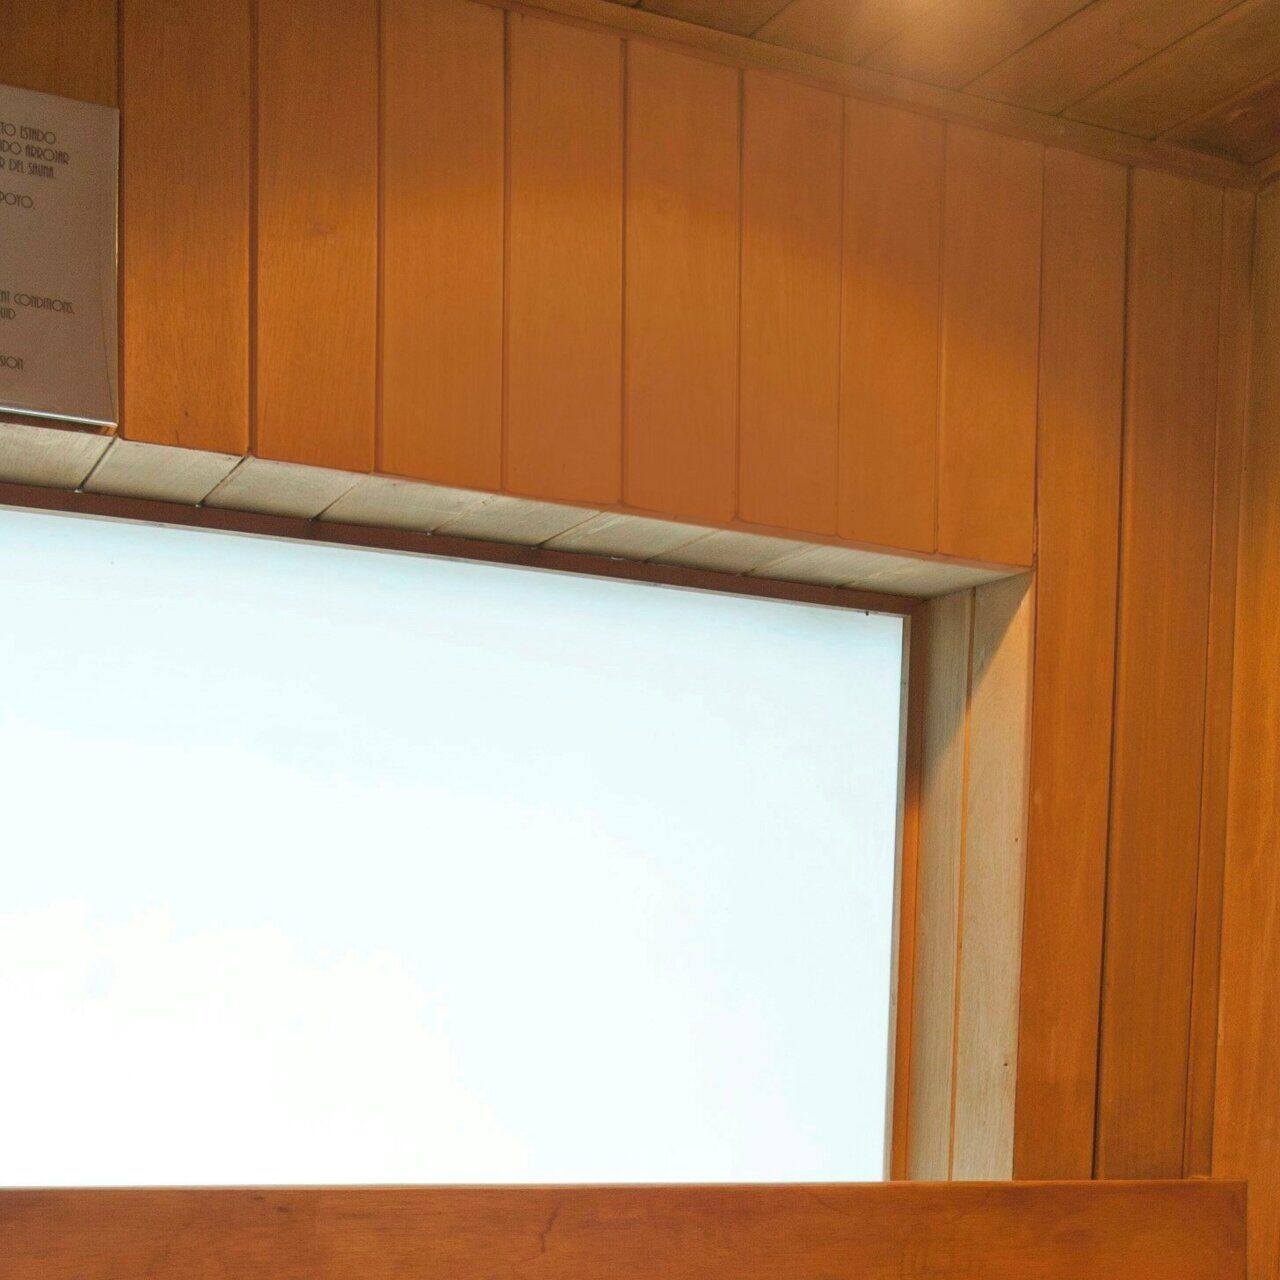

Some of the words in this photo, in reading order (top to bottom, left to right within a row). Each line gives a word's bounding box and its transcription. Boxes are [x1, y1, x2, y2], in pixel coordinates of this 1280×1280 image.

[21, 126, 57, 145] ESTADO
[25, 144, 70, 165] ARROJAR
[9, 160, 24, 175] DEL
